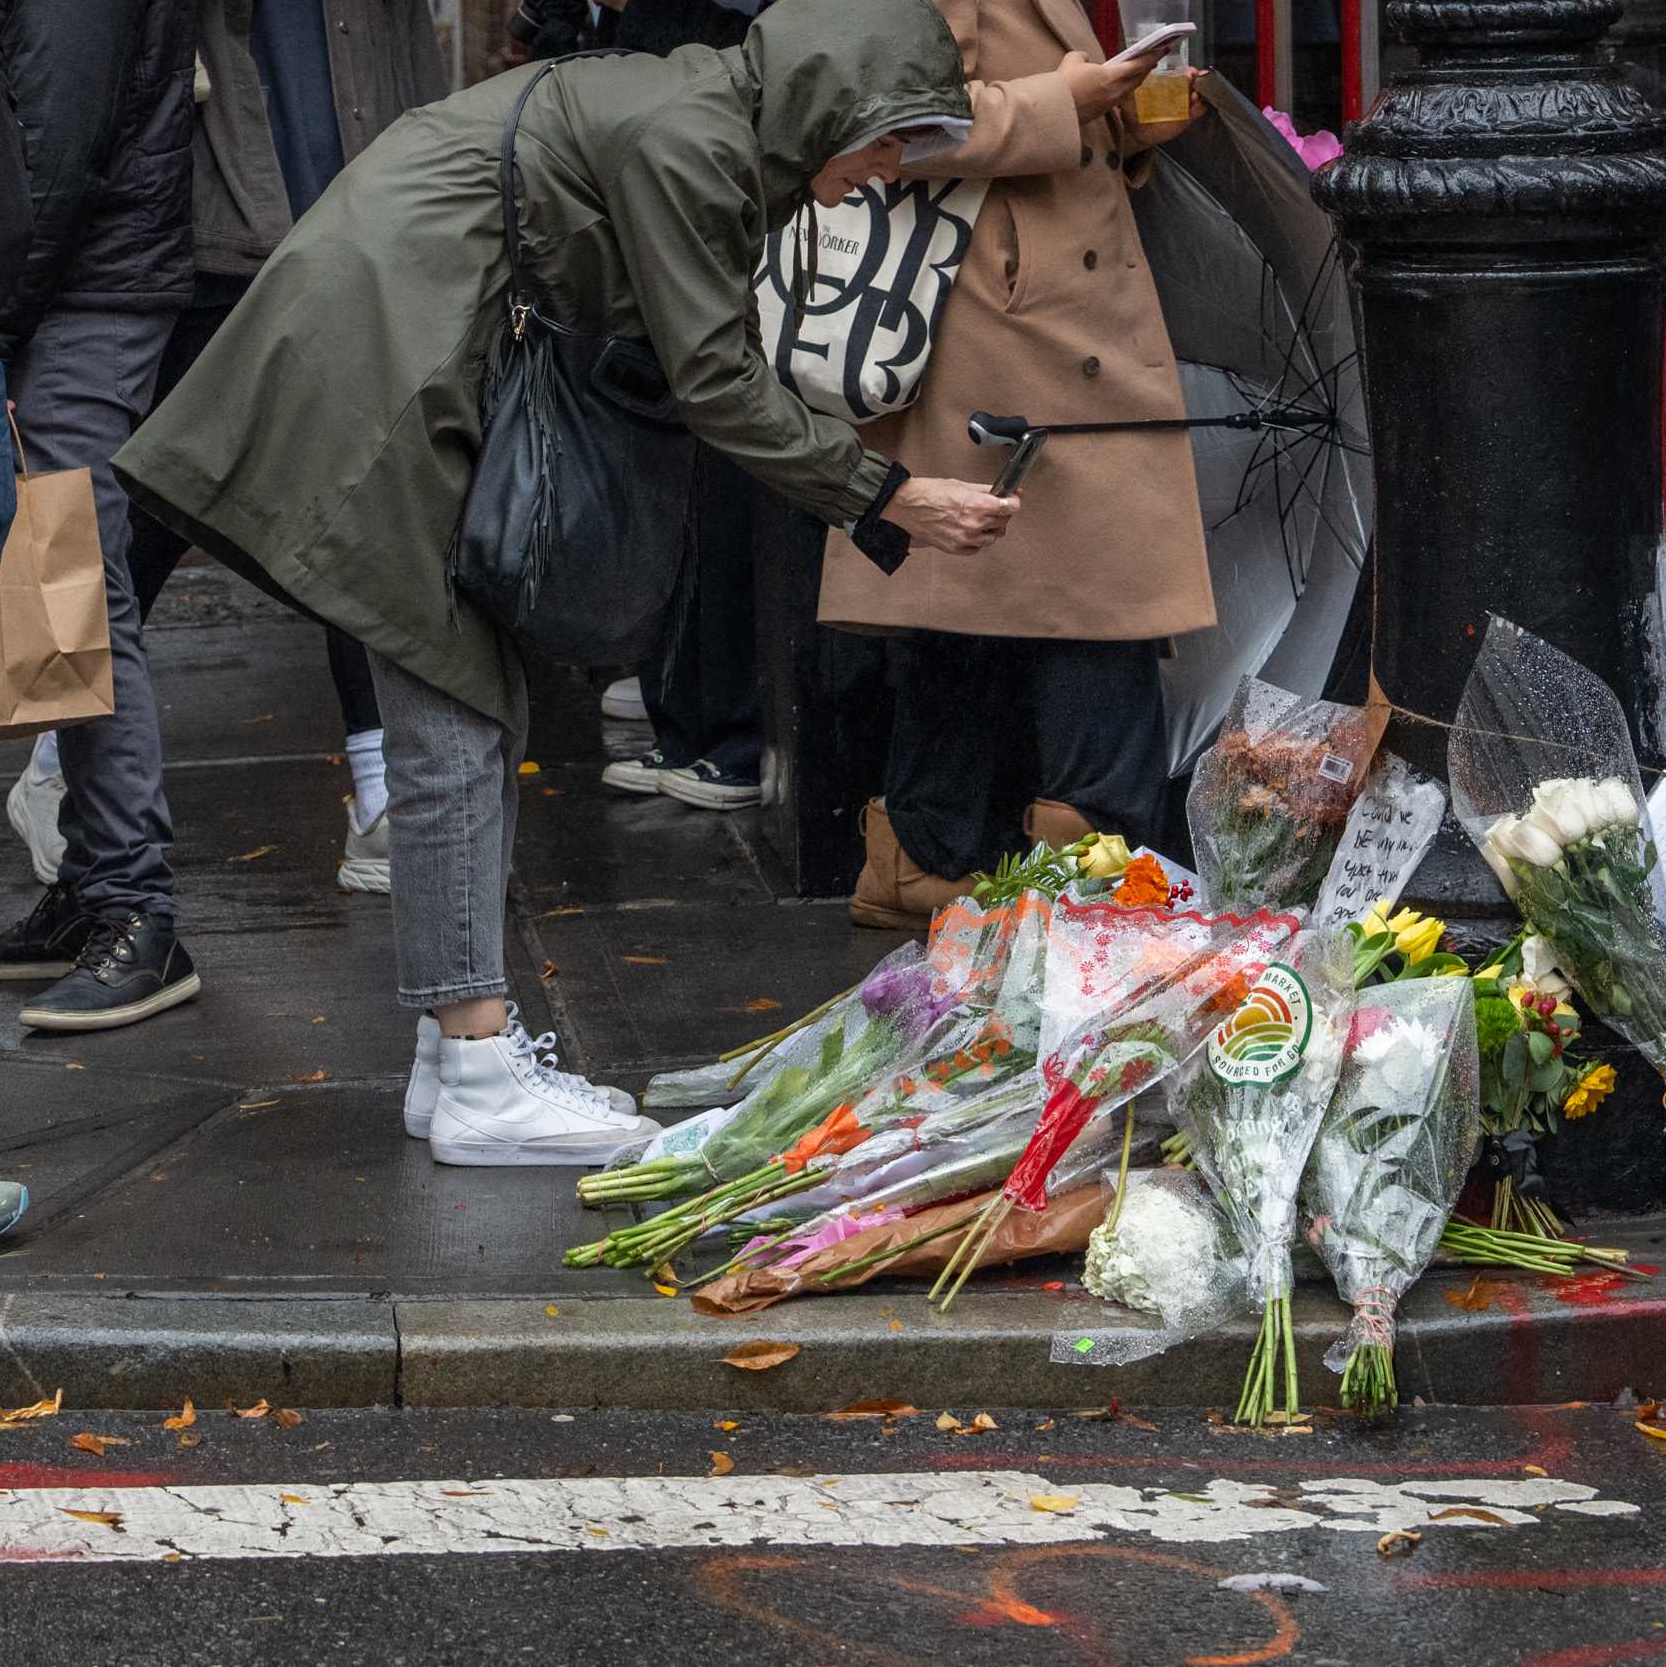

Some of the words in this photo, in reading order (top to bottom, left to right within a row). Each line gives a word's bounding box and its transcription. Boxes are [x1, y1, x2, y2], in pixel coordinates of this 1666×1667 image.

[819, 230, 860, 255] YORKER
[1262, 971, 1302, 1005] MARKET
[1212, 1053, 1260, 1077] SOURCED
[1265, 1058, 1286, 1077] FOR
